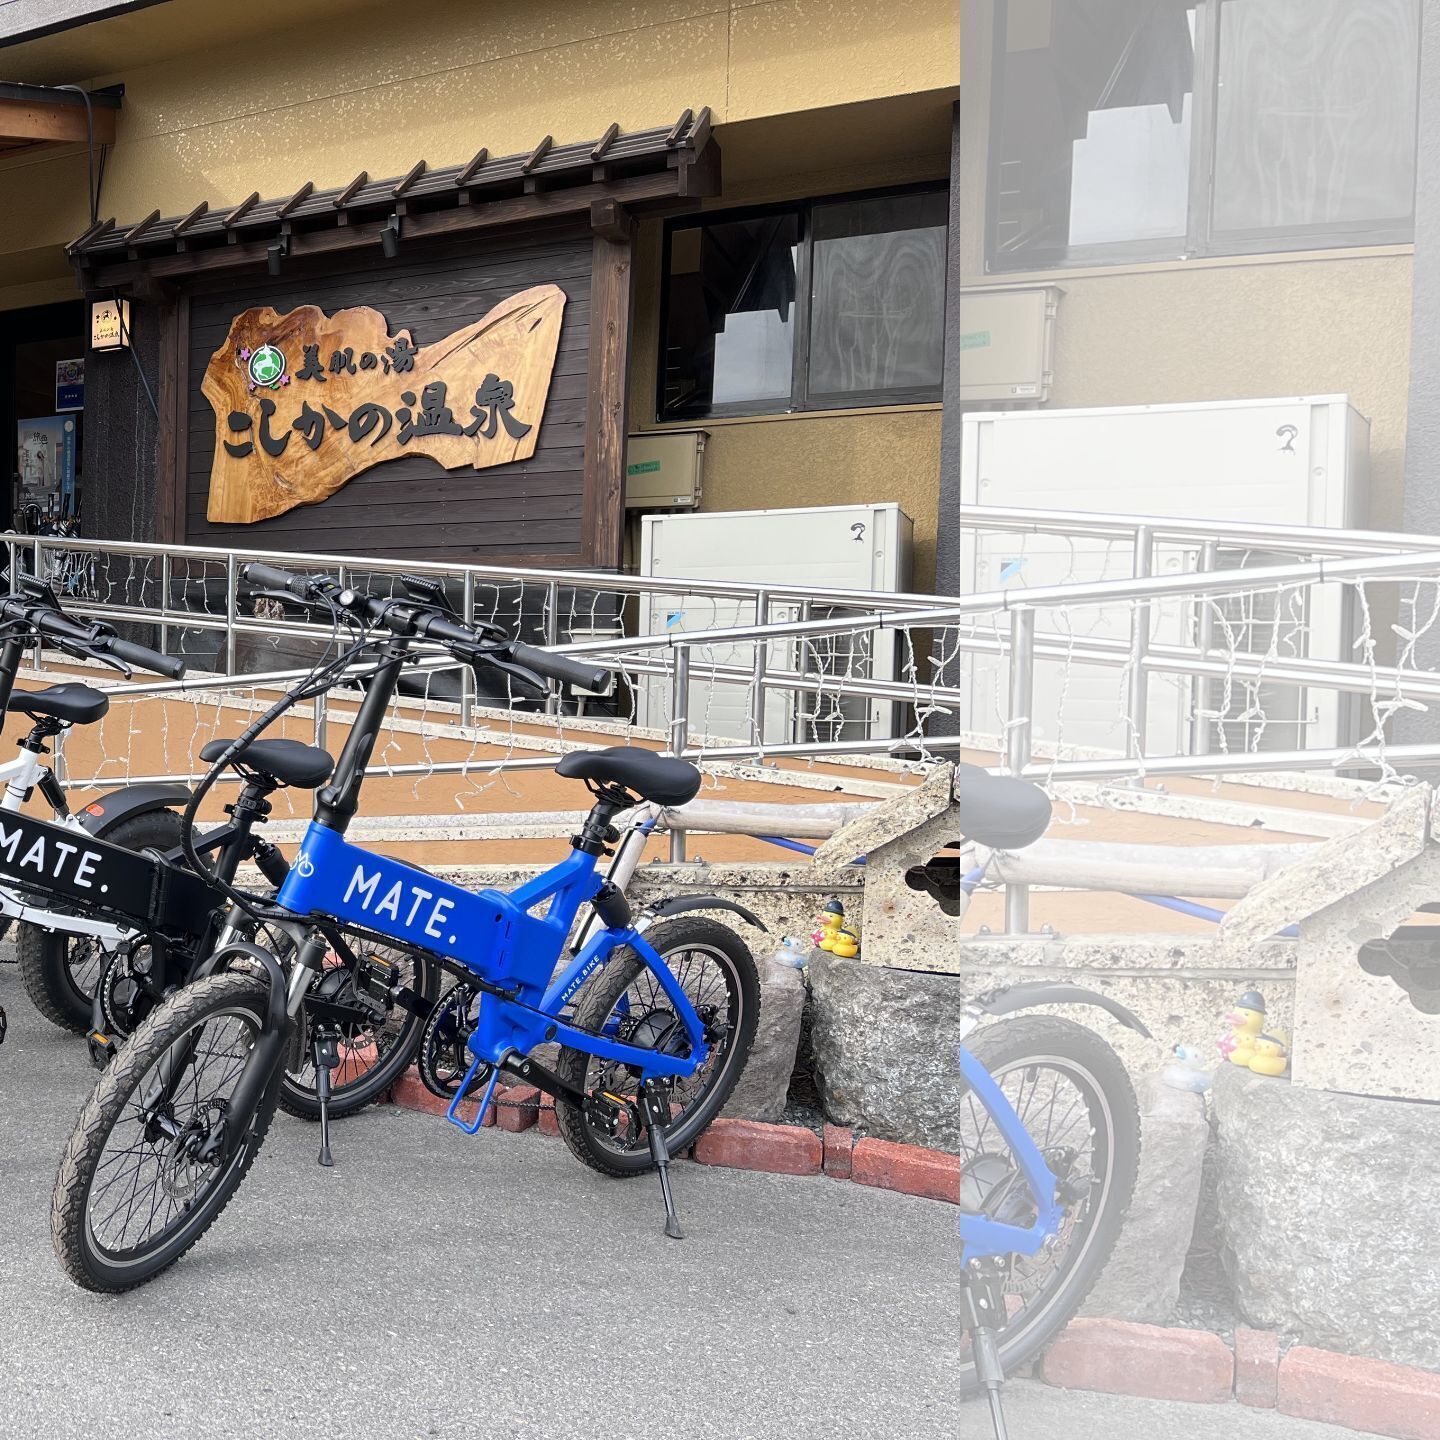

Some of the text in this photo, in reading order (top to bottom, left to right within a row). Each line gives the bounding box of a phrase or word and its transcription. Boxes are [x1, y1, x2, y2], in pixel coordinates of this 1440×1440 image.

[295, 336, 419, 382] 美肌の湯
[223, 373, 532, 458] こしかの温泉
[342, 864, 457, 944] MATE.
[561, 954, 600, 1002] MATE.BIKE
